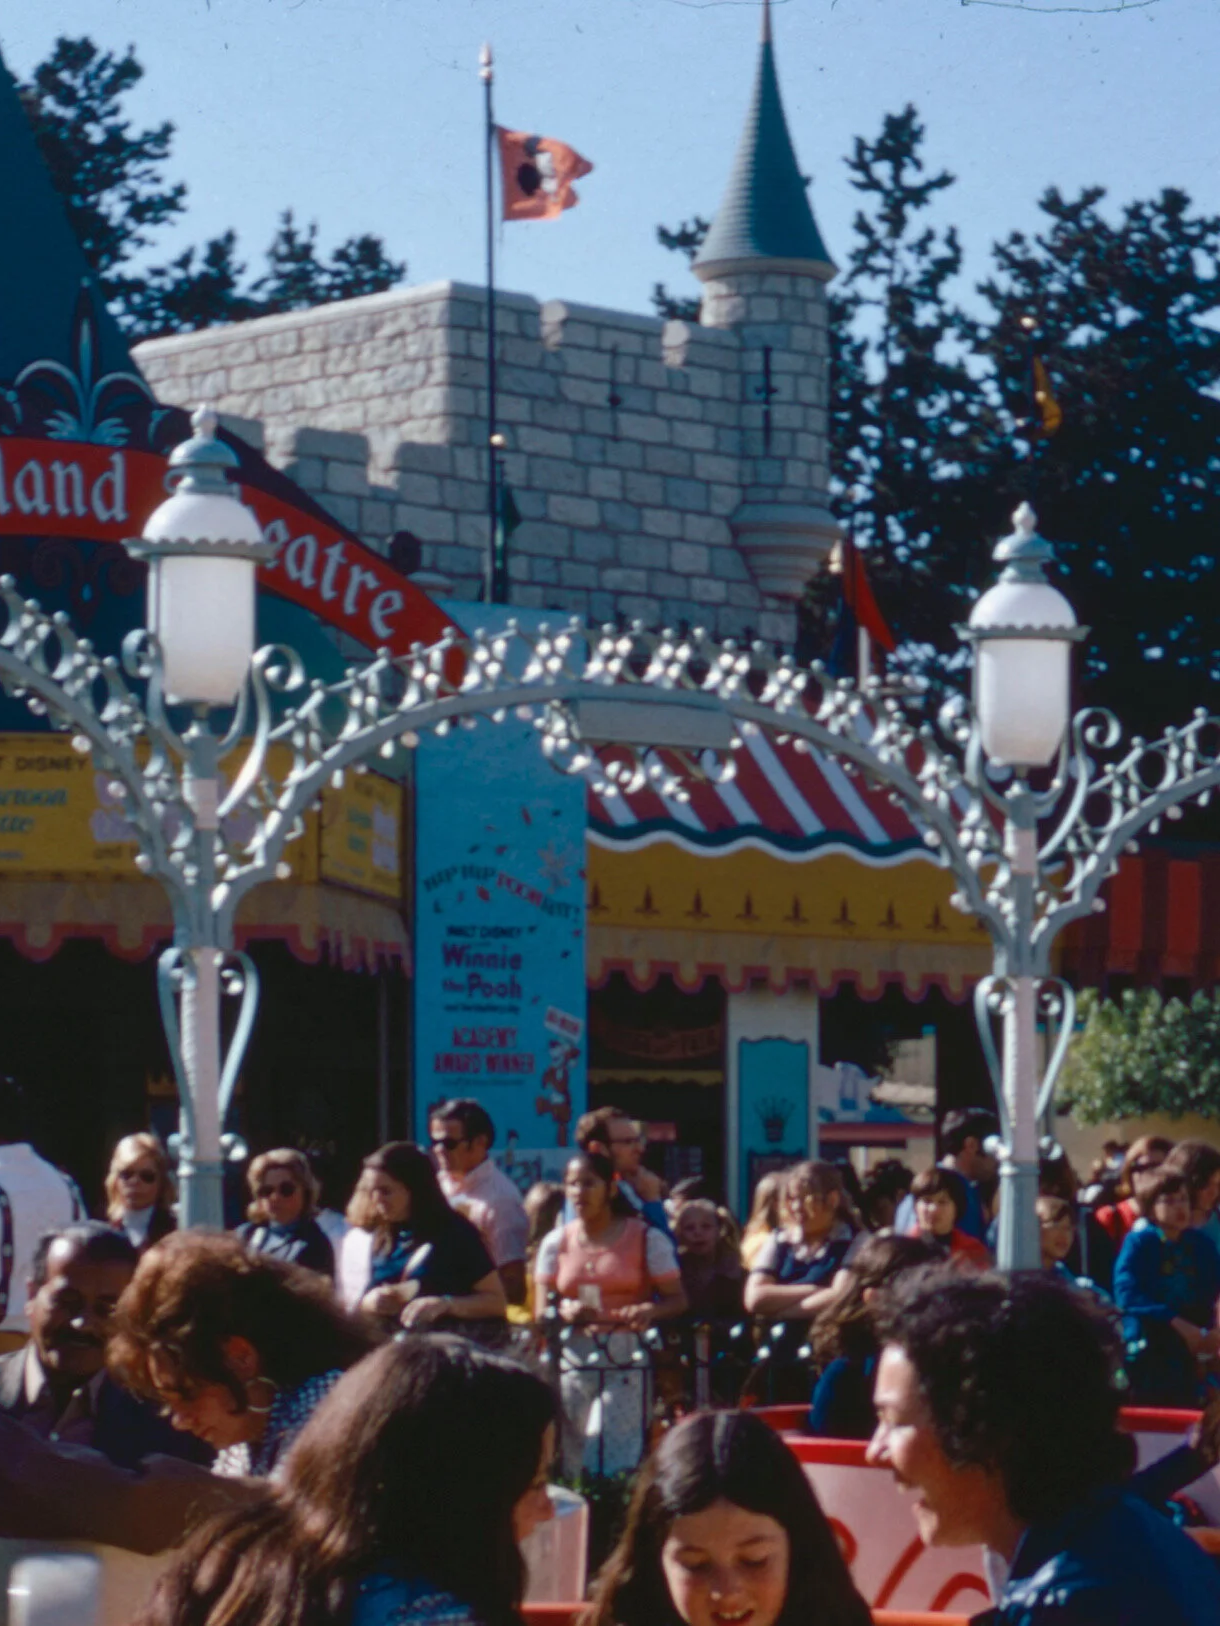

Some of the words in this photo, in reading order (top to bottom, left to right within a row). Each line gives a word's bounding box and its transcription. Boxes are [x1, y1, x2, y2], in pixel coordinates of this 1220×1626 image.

[15, 756, 89, 771] DISNEY
[442, 942, 523, 970] Winnie
[467, 972, 523, 999] Pooh
